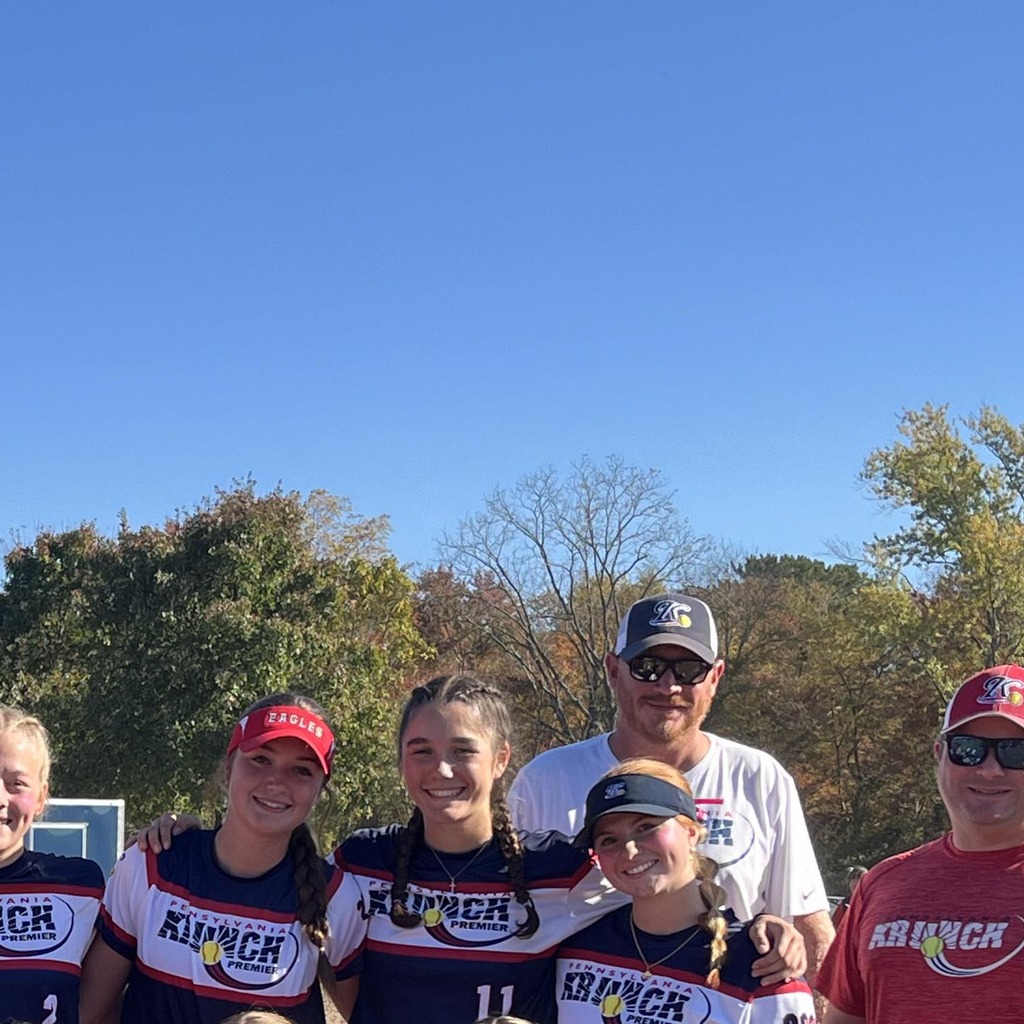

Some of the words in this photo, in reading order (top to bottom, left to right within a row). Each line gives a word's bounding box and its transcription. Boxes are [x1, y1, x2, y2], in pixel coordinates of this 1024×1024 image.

[268, 712, 323, 738] EAGLES
[369, 889, 512, 922] KUNCH
[1, 932, 57, 942] PREMIER
[450, 920, 509, 932] PREMIER
[868, 919, 1010, 951] KRUNCH
[227, 960, 279, 975] PREMIER
[477, 984, 515, 1021] 11
